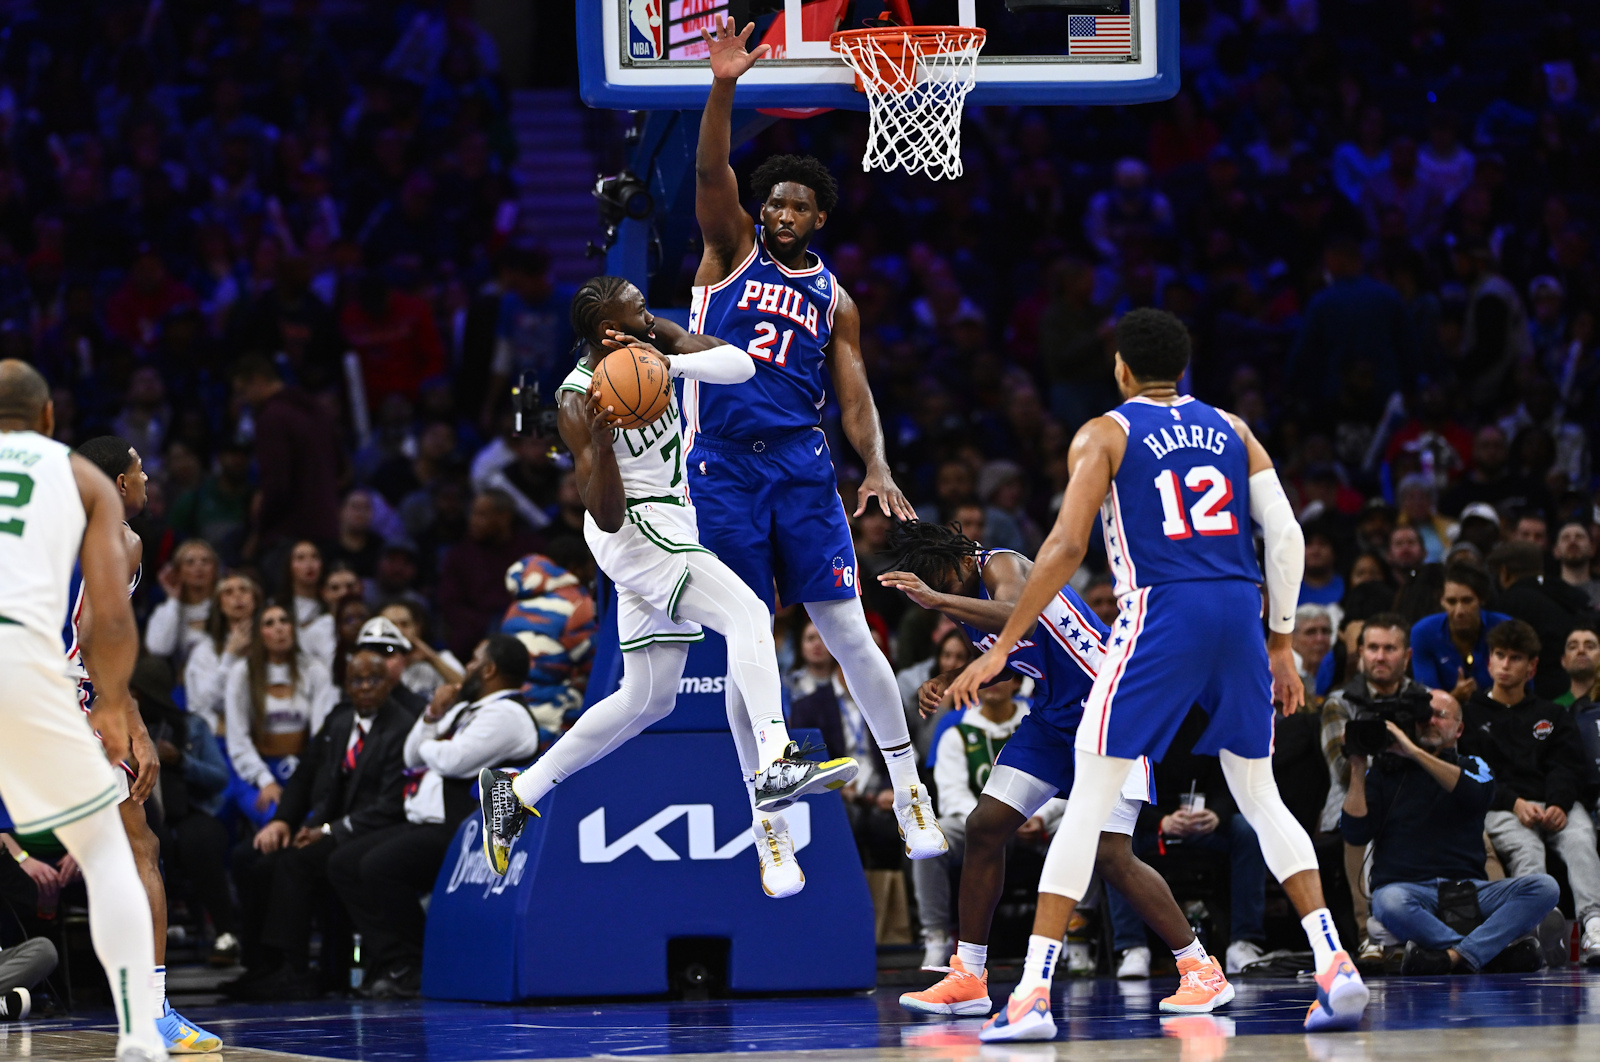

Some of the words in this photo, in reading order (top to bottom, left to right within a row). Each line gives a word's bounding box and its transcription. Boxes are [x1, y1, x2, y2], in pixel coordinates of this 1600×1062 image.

[632, 41, 650, 56] NBA
[737, 279, 820, 339] PHILA
[746, 320, 796, 368] 21
[659, 431, 682, 488] 7
[1143, 424, 1229, 460] HARRIS
[1154, 465, 1239, 541] 12
[832, 566, 854, 588] 76
[499, 782, 508, 817] MEANS
